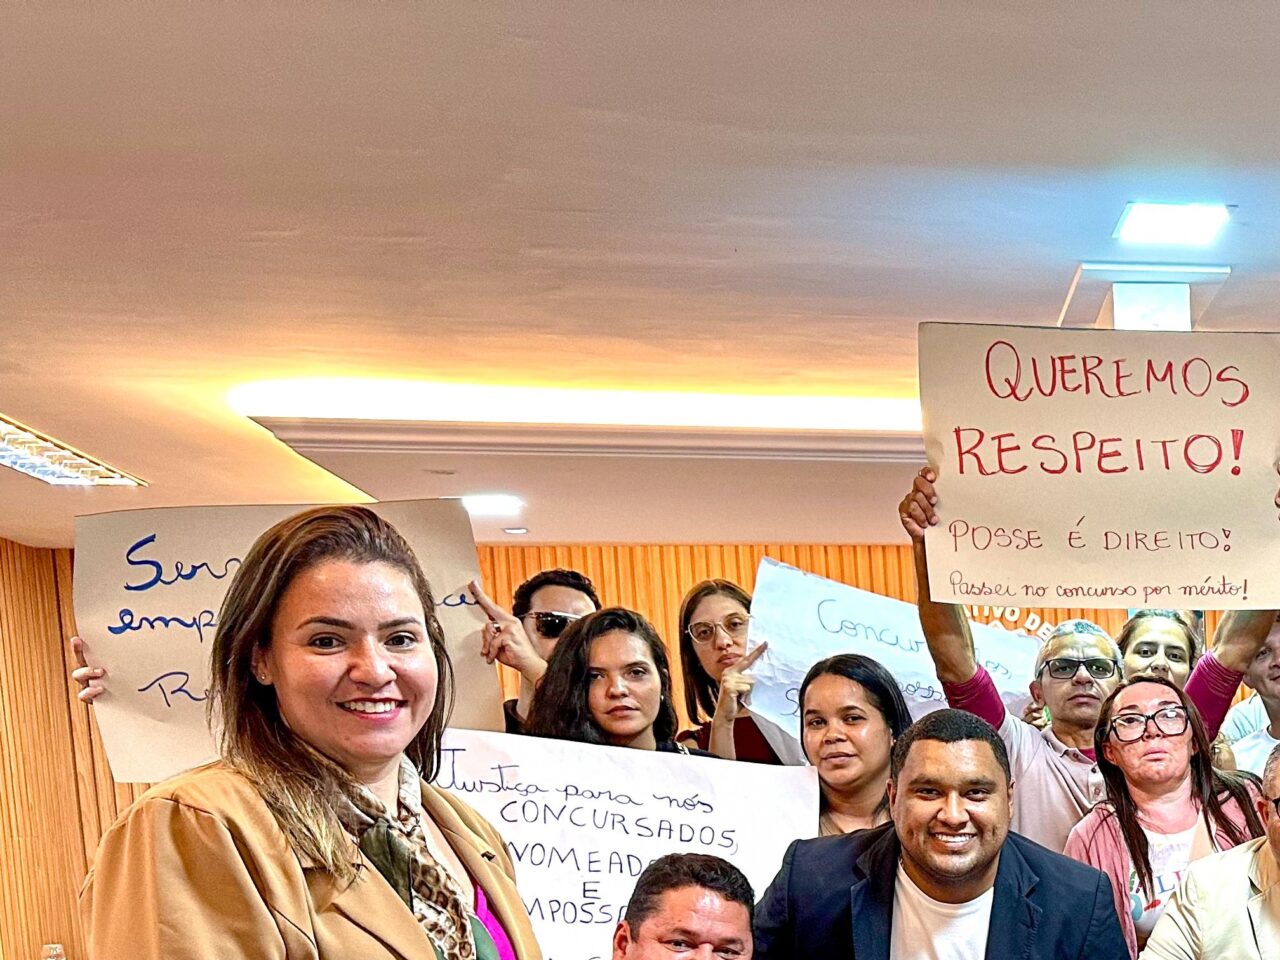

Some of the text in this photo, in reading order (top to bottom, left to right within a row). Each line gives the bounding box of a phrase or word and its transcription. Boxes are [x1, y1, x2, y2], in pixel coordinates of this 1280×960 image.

[985, 340, 1250, 408] QUEREMOS
[953, 426, 1245, 476] RESPEITO!
[948, 515, 1234, 553] POSSE É DIREITO!
[949, 570, 1249, 603] Passei no concurso por mérito!
[435, 748, 715, 814] Justiça para nós
[583, 880, 602, 900] E
